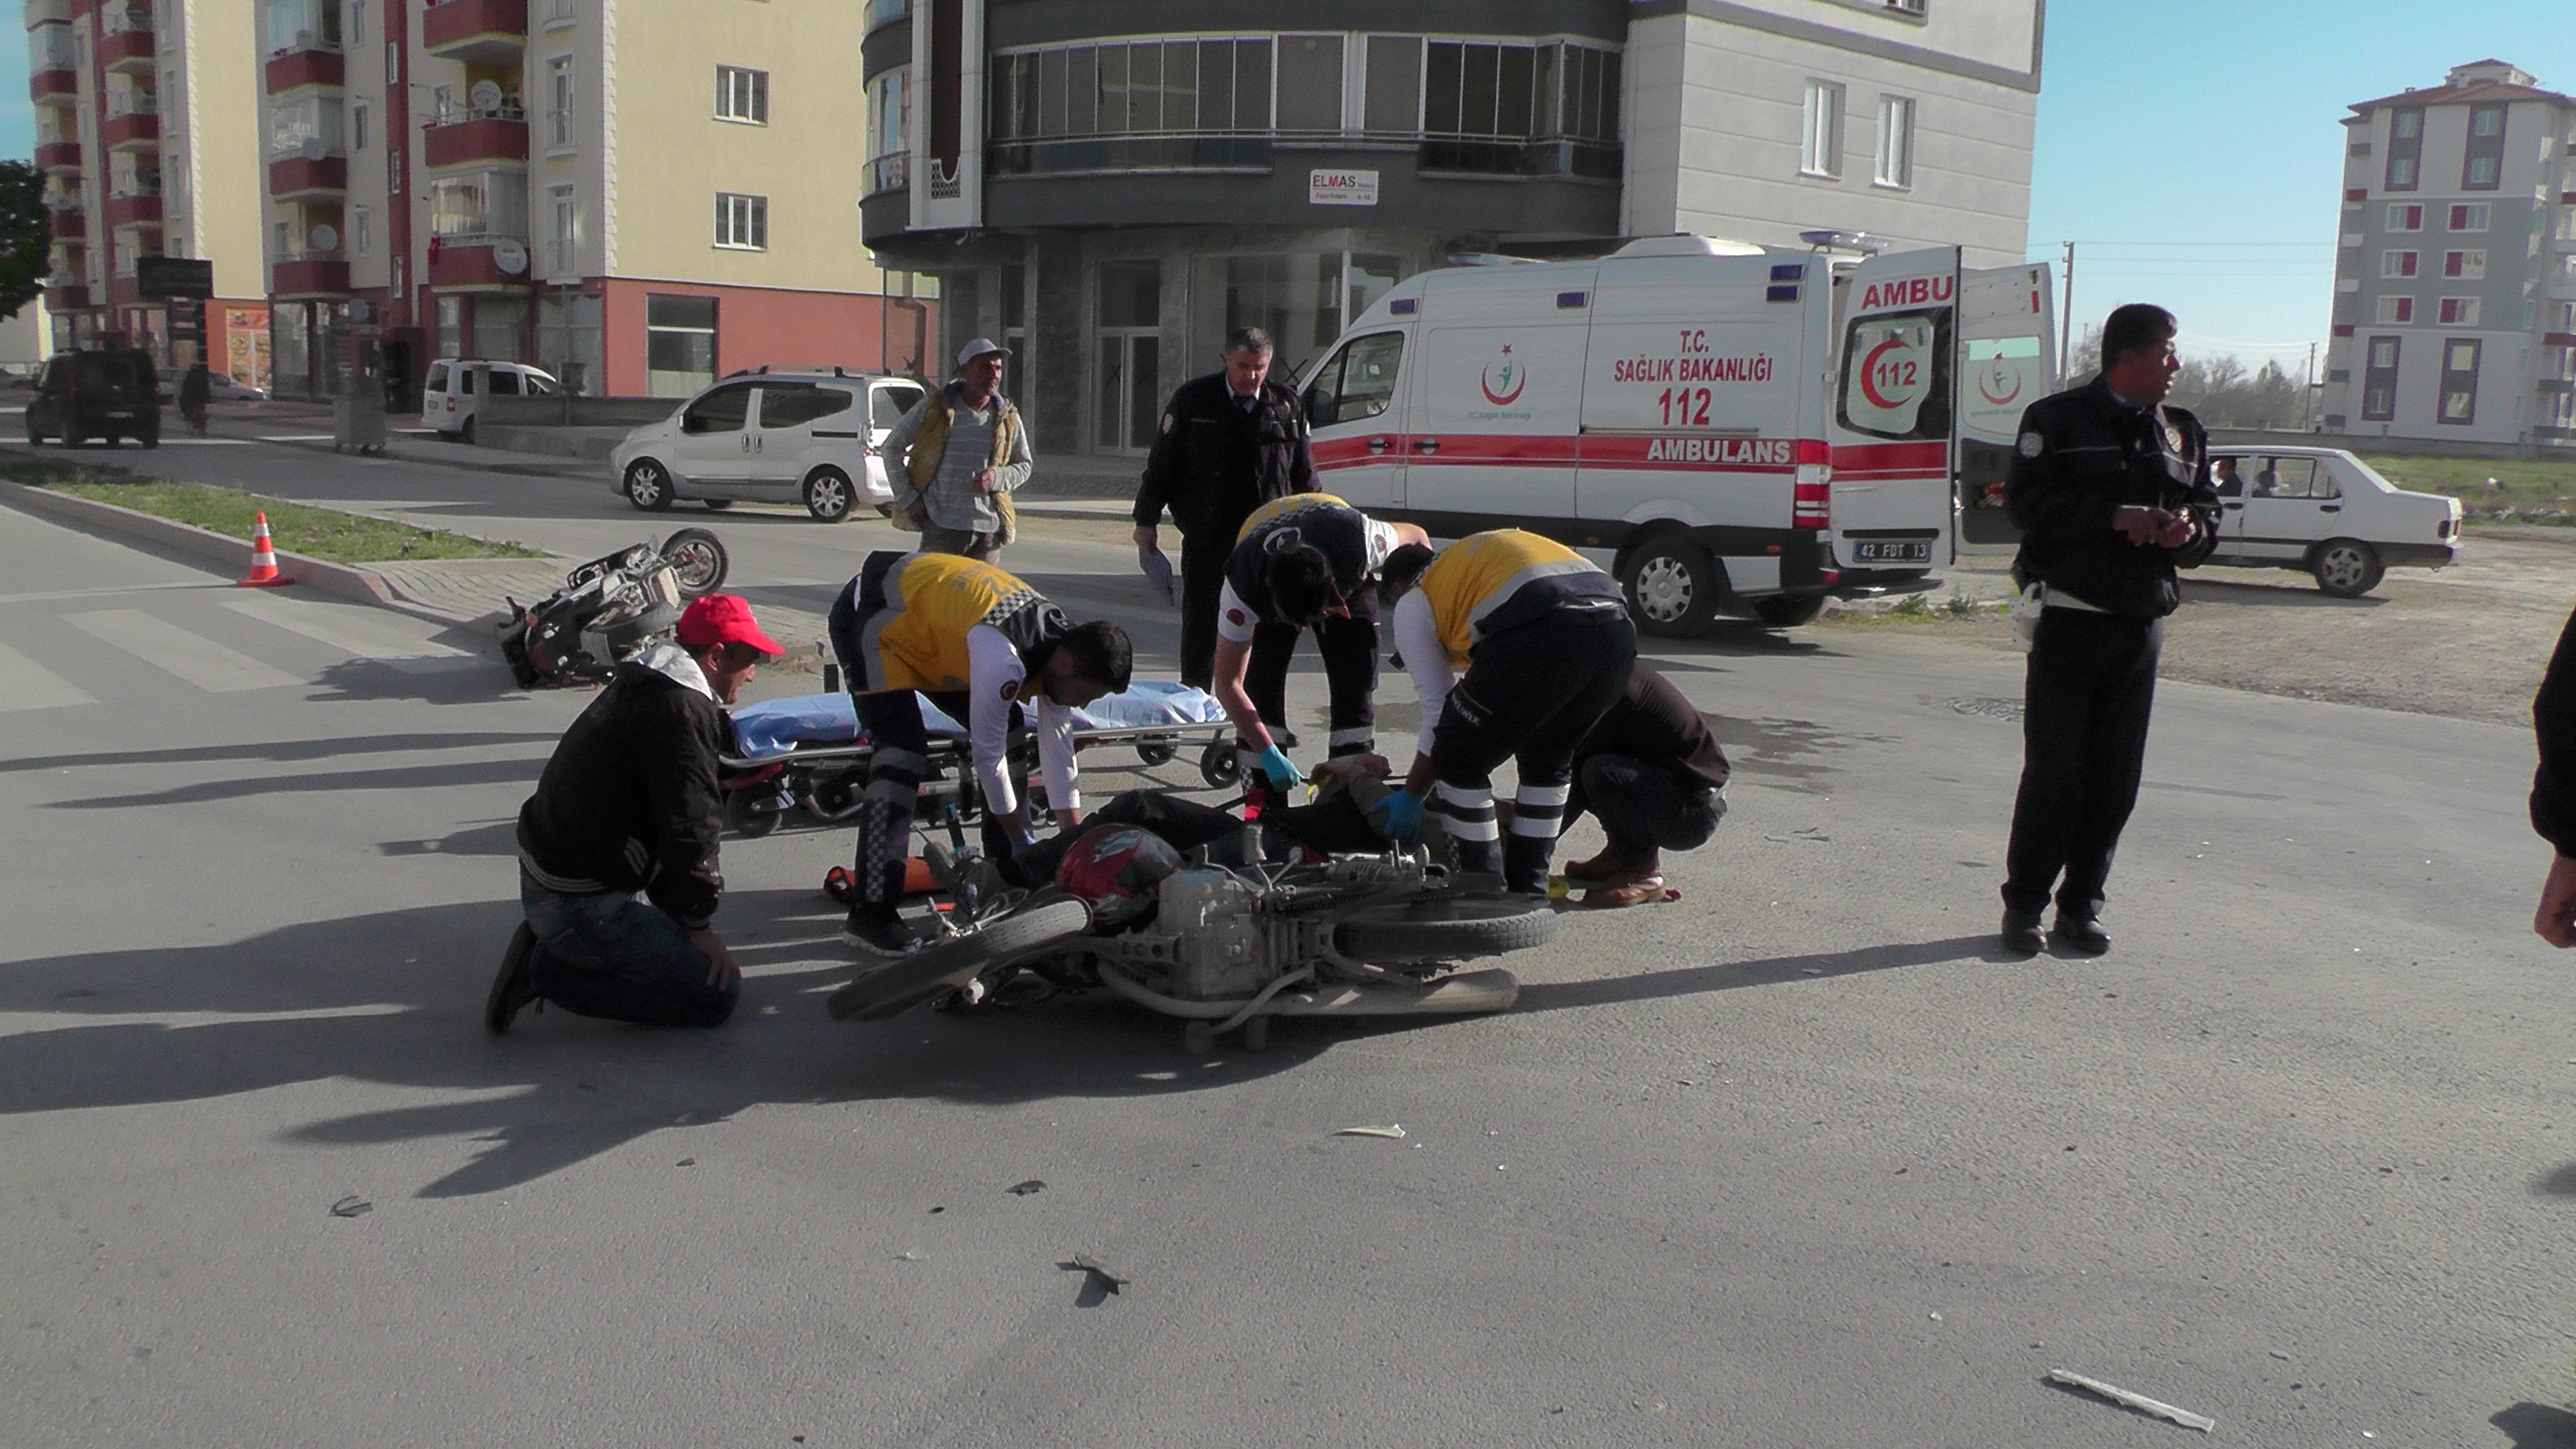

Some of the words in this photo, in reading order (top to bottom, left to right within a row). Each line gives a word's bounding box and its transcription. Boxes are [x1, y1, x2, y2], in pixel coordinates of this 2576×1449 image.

[1313, 175, 1356, 187] ELMAS
[1861, 275, 1953, 310] AMBU
[1680, 330, 1709, 353] T.C.
[1614, 354, 1675, 382] SAĞLIK
[1679, 352, 1773, 381] BAKANLIĞI
[1877, 360, 1917, 387] 112
[1658, 388, 1712, 426] 112
[1647, 439, 1790, 464] AMBULANS
[1862, 544, 1875, 557] 42
[1914, 544, 1926, 557] 13
